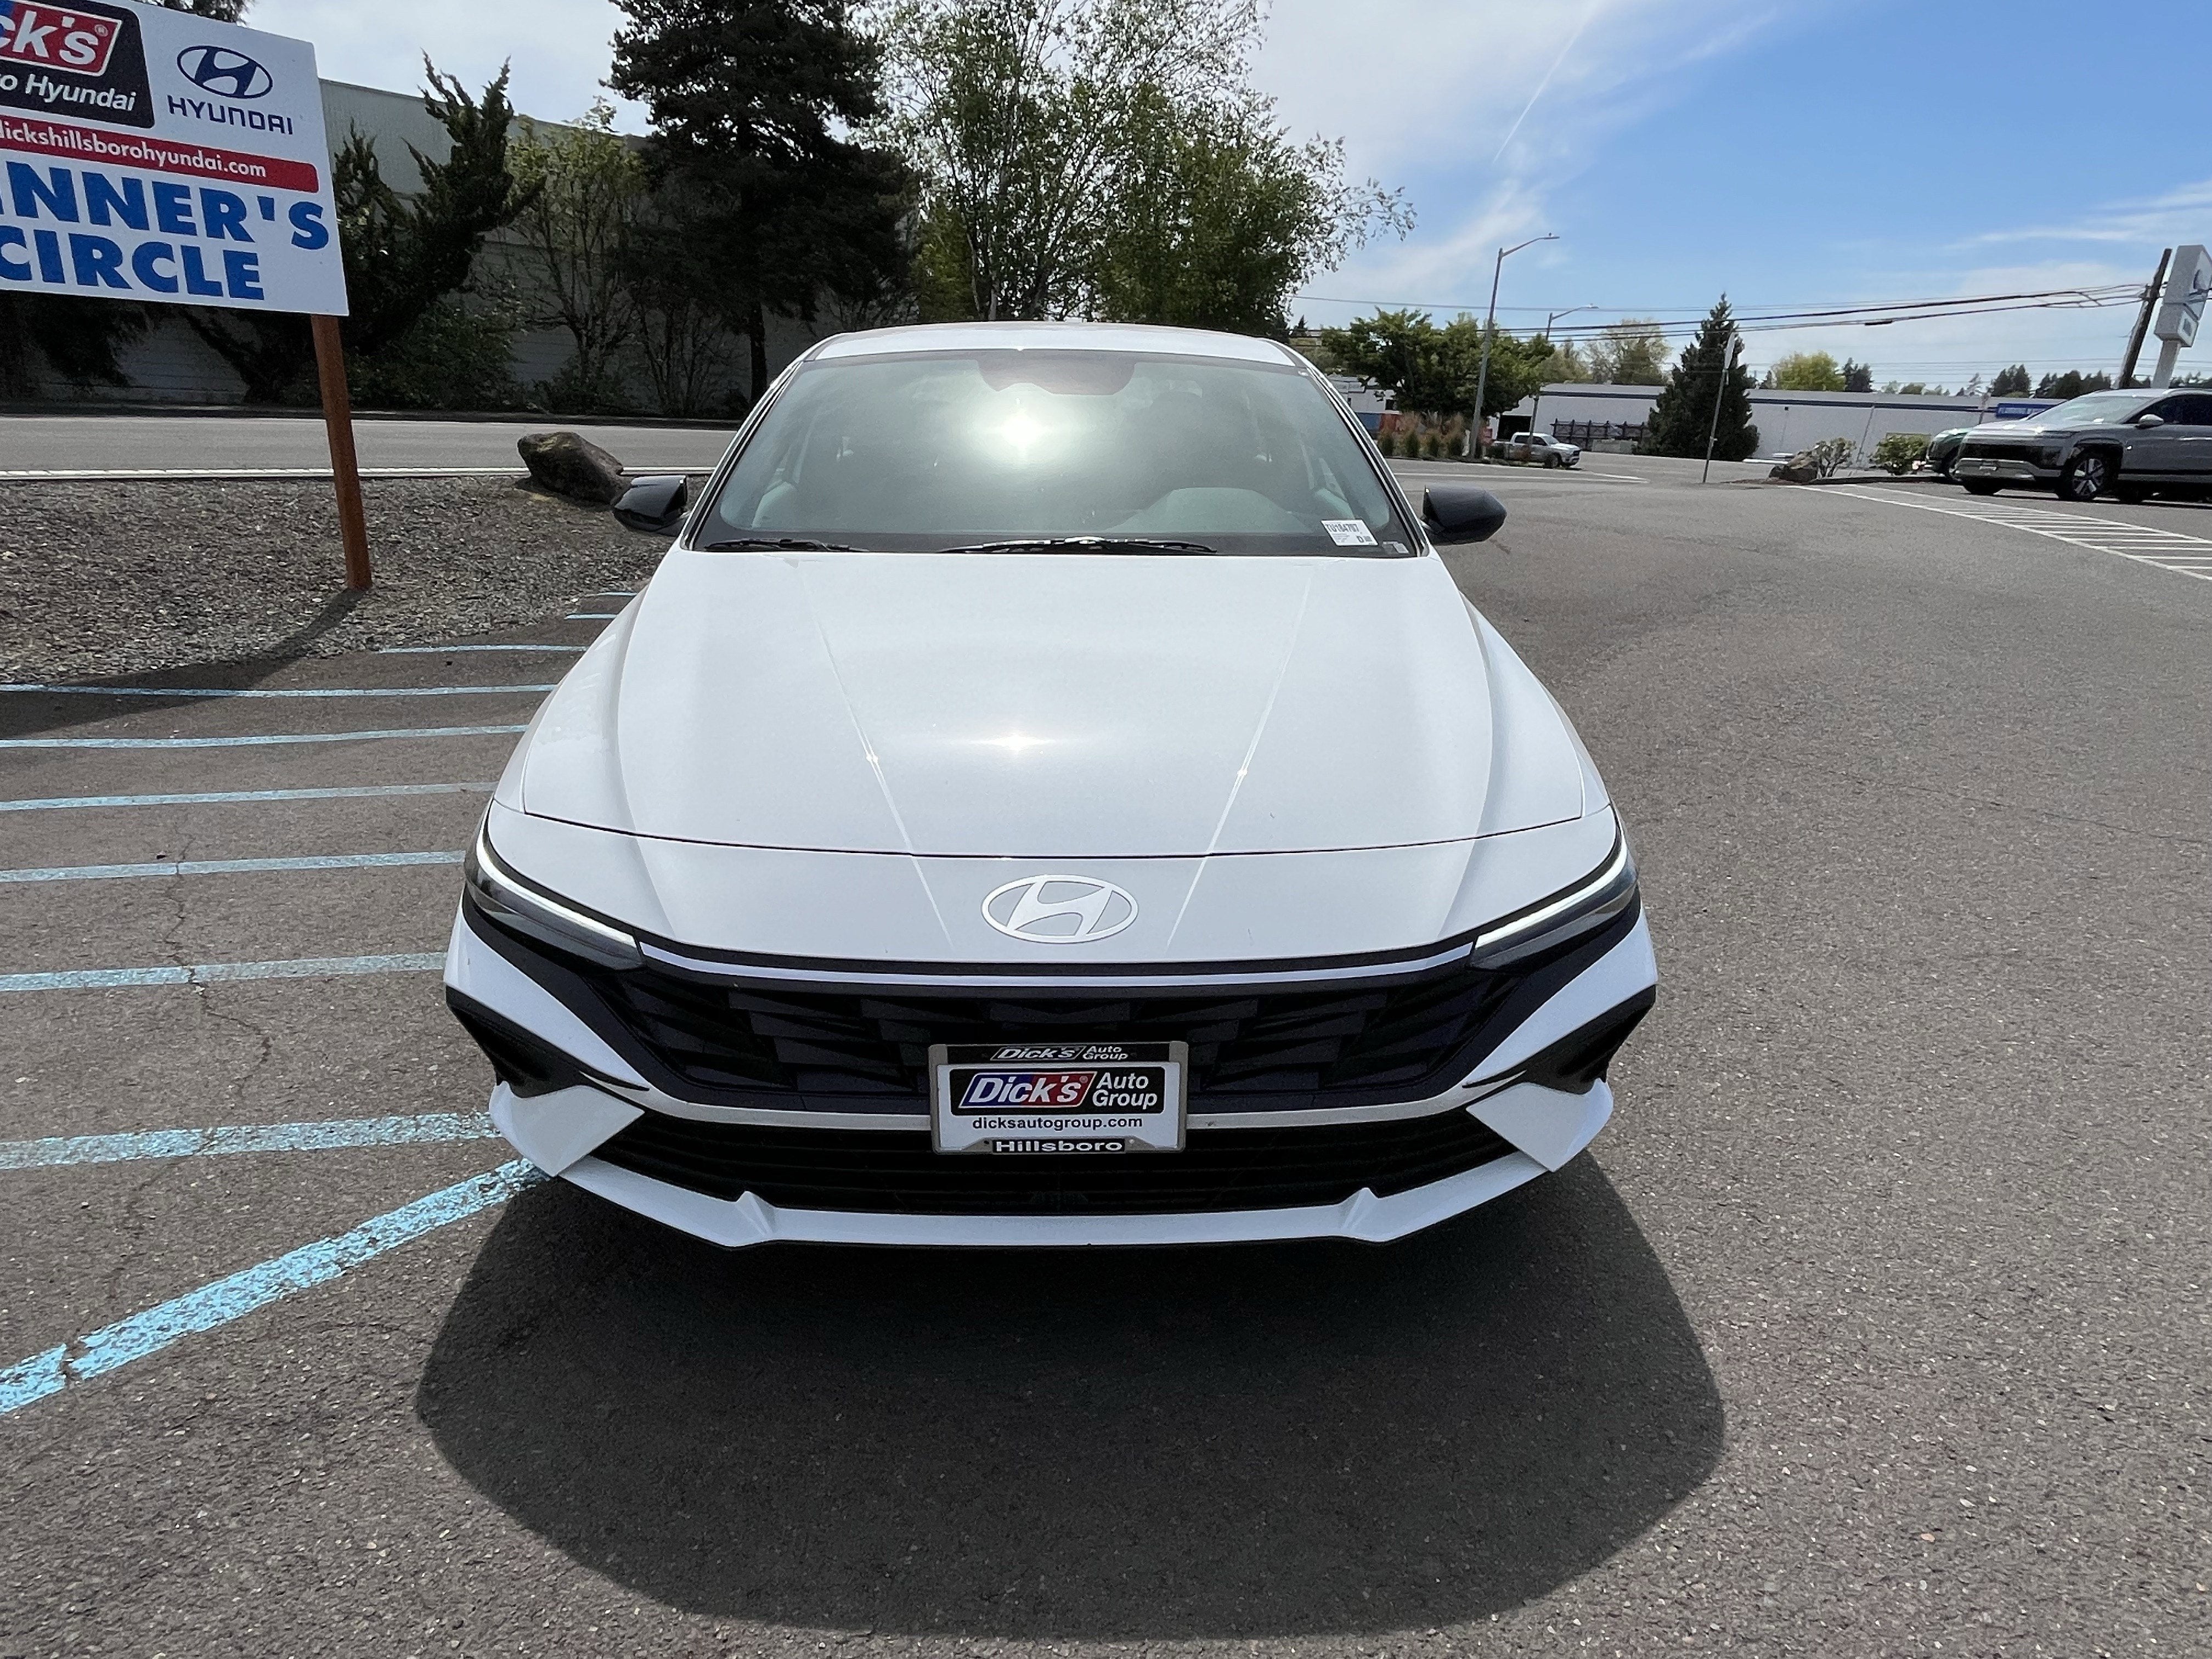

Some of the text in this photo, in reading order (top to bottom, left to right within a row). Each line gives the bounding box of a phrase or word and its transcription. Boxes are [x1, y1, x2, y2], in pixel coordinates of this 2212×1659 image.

[25, 74, 136, 111] Hyundai
[168, 95, 294, 135] HYUNDAI
[0, 161, 329, 250] NNER'S
[0, 225, 264, 301] CIRCLE
[996, 1047, 1075, 1059] Dick's
[1082, 1052, 1128, 1060] Group
[969, 1075, 1081, 1103] Dick's
[1097, 1072, 1149, 1090] Auto
[1092, 1090, 1158, 1110] Group
[972, 1117, 1143, 1131] dicksautogroup.com
[996, 1141, 1122, 1152] Hillsboro
